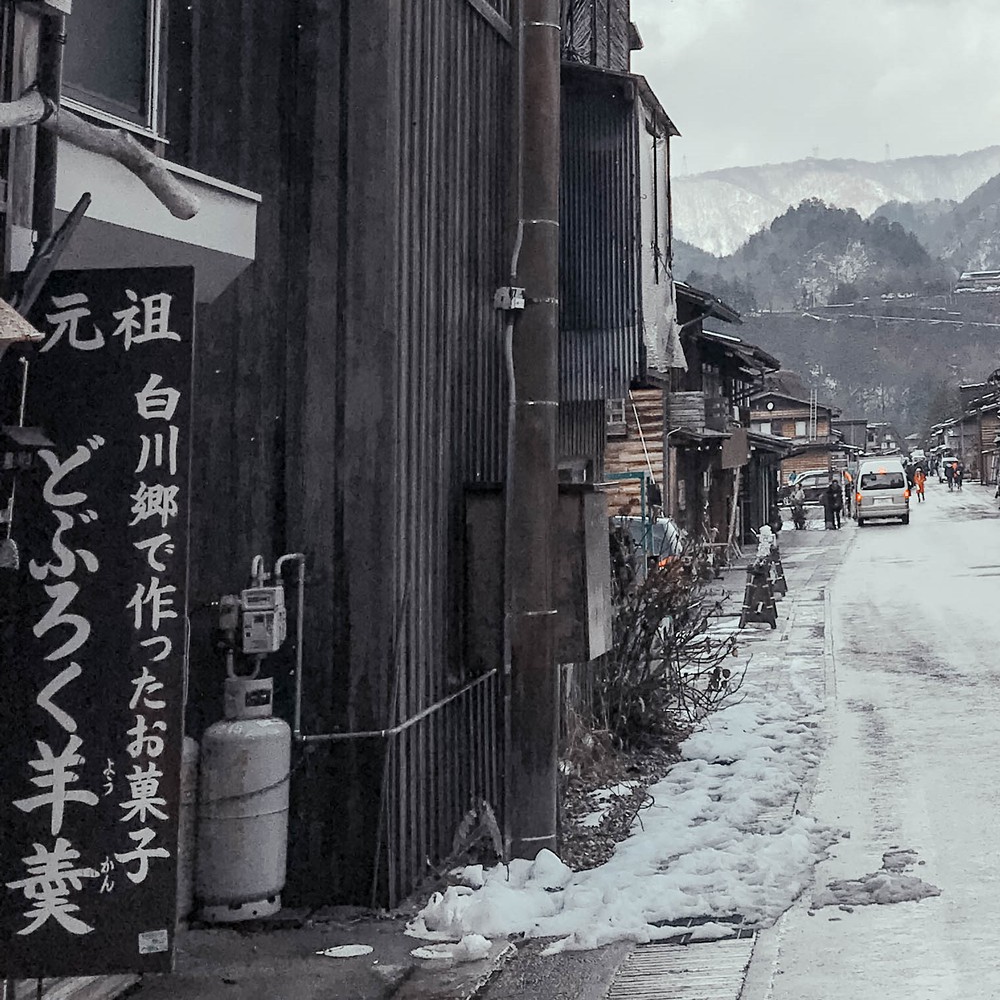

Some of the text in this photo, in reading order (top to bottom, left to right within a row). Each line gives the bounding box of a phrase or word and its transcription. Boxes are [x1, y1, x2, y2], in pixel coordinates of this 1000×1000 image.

[39, 288, 182, 353] 元祖
[113, 373, 181, 884] 白川郷で作ったお菓子
